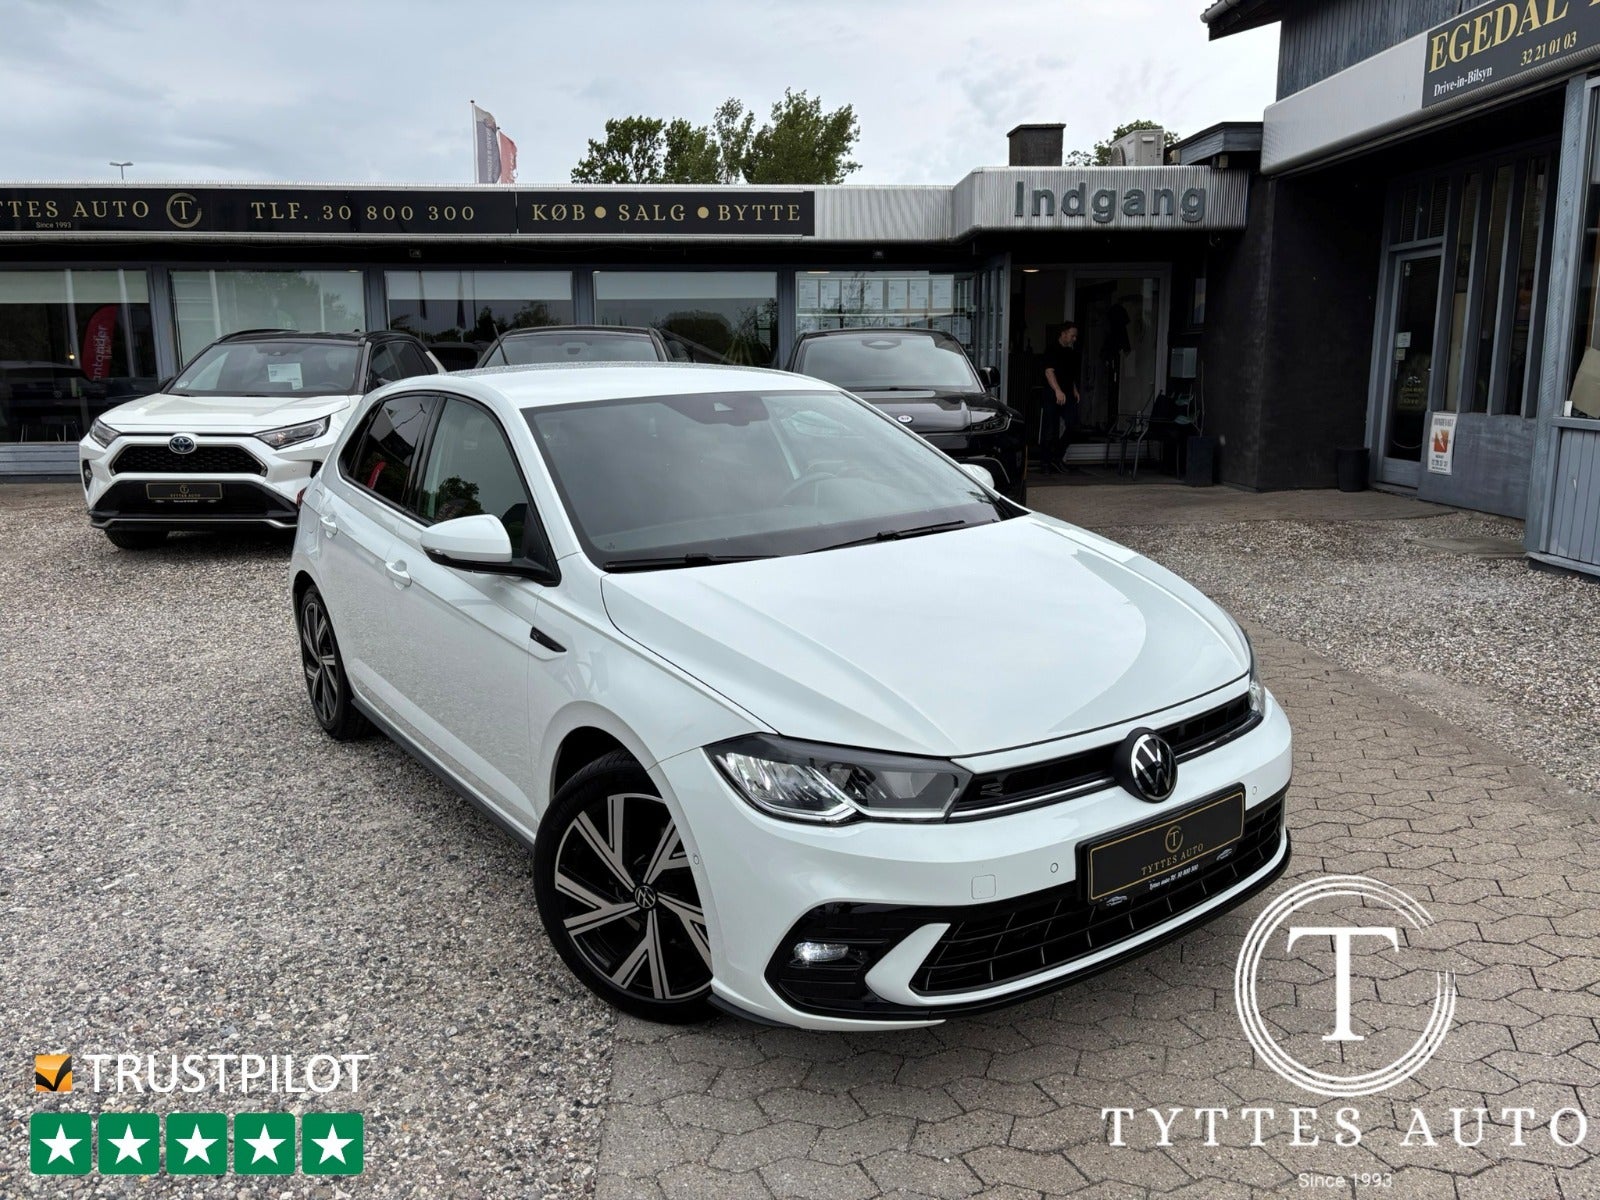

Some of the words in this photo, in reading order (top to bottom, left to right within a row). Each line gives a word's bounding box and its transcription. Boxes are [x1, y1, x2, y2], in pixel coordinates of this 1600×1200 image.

[1428, 0, 1569, 74] EGEDAL
[1520, 50, 1533, 67] 32
[1534, 44, 1547, 62] 21
[1549, 38, 1562, 55] 01
[1563, 31, 1578, 49] 03
[1433, 66, 1493, 97] Drive-in-Bilsyn
[0, 200, 59, 218] TES
[72, 200, 150, 219] AUTO
[251, 202, 309, 220] TLF.
[322, 204, 353, 221] 30
[366, 205, 415, 221] 800
[427, 205, 475, 221] 300
[531, 204, 587, 222] KØB
[618, 204, 686, 222] SALG
[717, 204, 801, 222] BYTTE
[1014, 180, 1207, 224] Indgang
[35, 221, 54, 229] Since
[55, 221, 72, 230] 1993
[1141, 854, 1178, 876] TYTTES
[1180, 843, 1204, 860] AUTO
